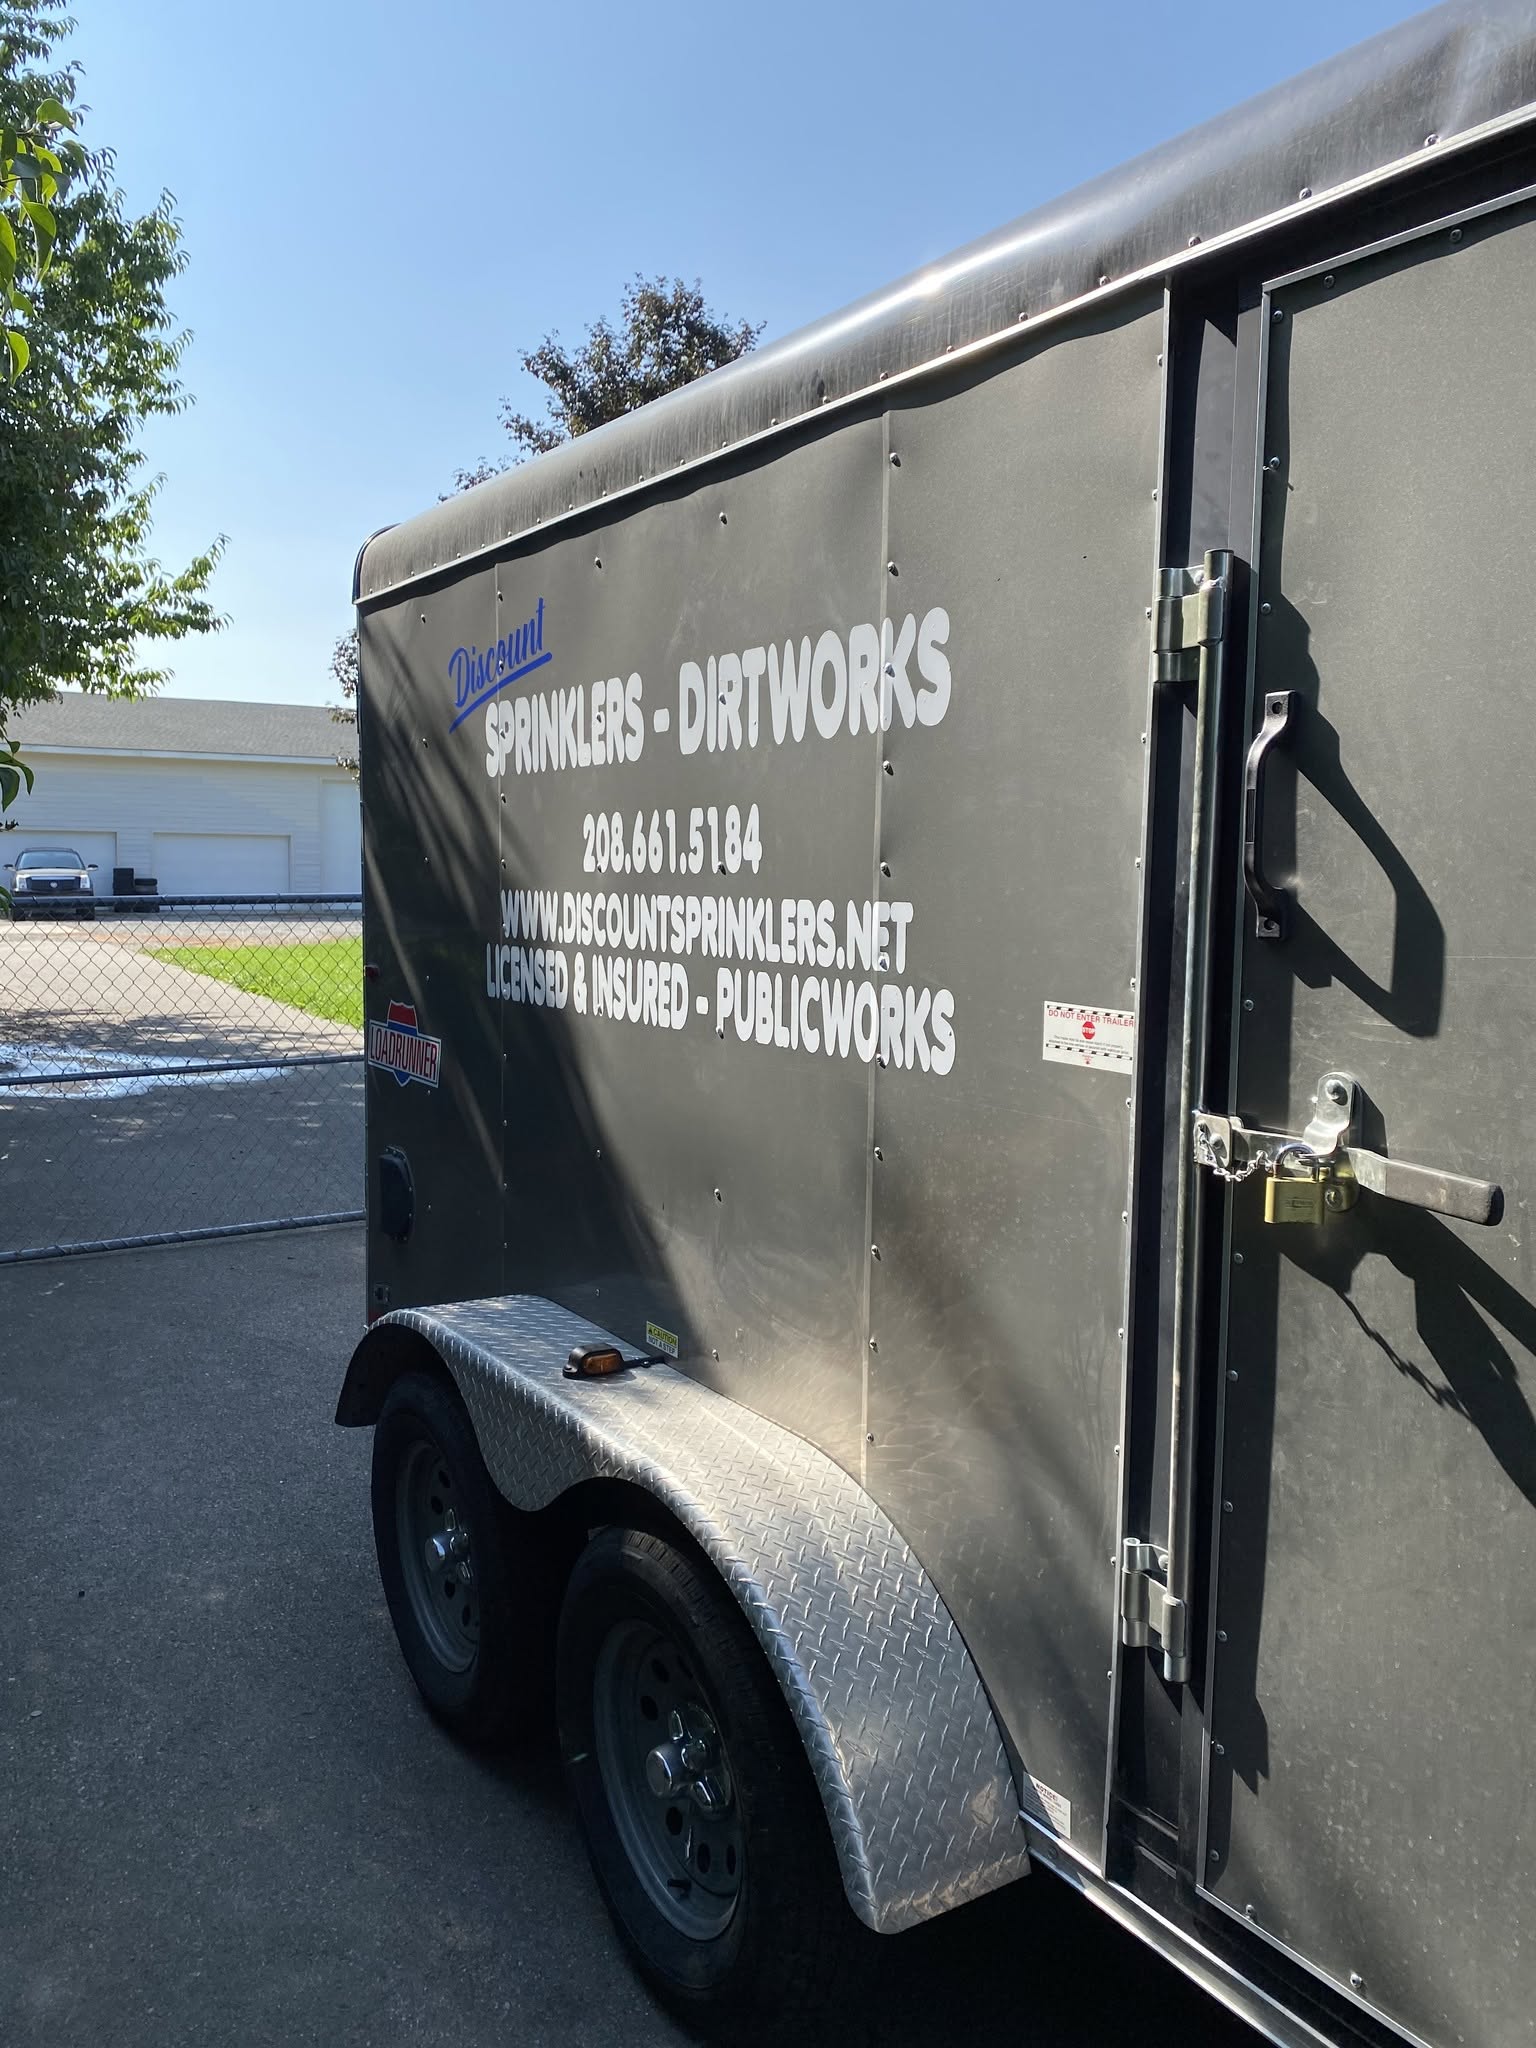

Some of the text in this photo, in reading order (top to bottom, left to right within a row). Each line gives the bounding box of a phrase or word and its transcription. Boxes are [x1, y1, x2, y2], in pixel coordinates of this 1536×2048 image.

[448, 597, 553, 734] Discount
[486, 607, 952, 777] SPRINKLERS - DIRTWORKS
[583, 803, 763, 875] 208.661.5184
[500, 889, 914, 975] WWW.DISCOUNTSPRINKLERS.NET
[486, 943, 956, 1076] LICENSED & INSURED - PUBLICWORKS
[1048, 1009, 1134, 1027] DO NOT ENTER TRAILER
[1082, 1026, 1096, 1035] STOP
[370, 1026, 438, 1080] LOADRUNNER
[648, 1335, 659, 1345] NOT
[663, 1343, 676, 1353] STEP
[653, 1328, 677, 1346] CAUTION
